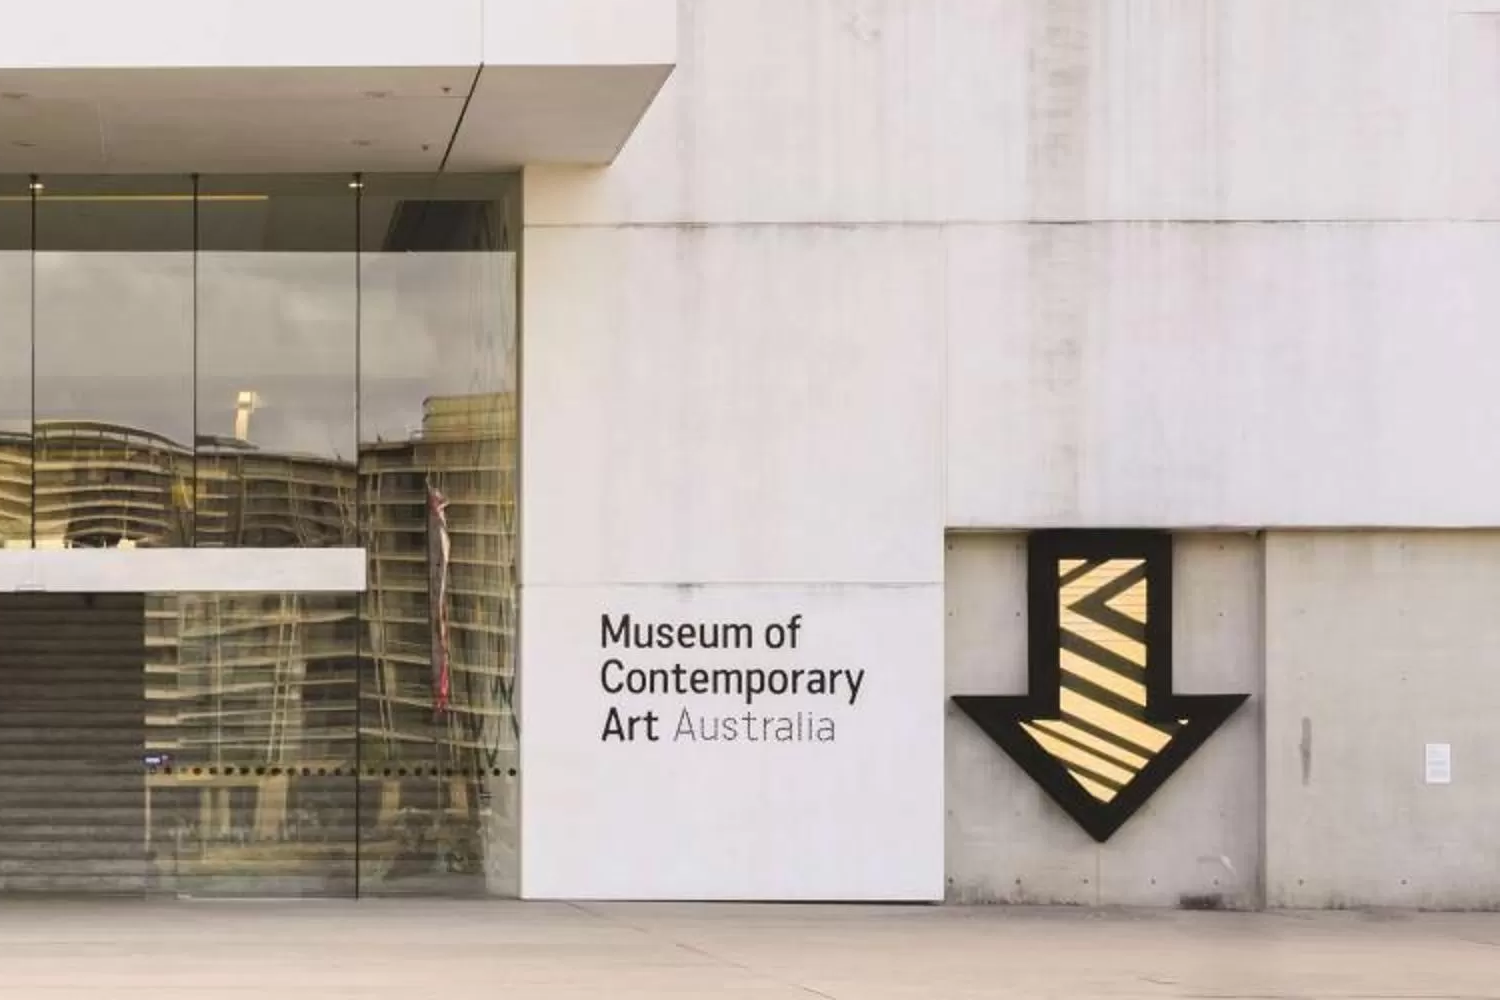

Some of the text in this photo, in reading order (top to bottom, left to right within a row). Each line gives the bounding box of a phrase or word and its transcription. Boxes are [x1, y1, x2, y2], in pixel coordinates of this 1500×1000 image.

[601, 614, 802, 648] Museum of
[601, 658, 865, 705] Contemporary
[601, 706, 836, 742] Art Australia
